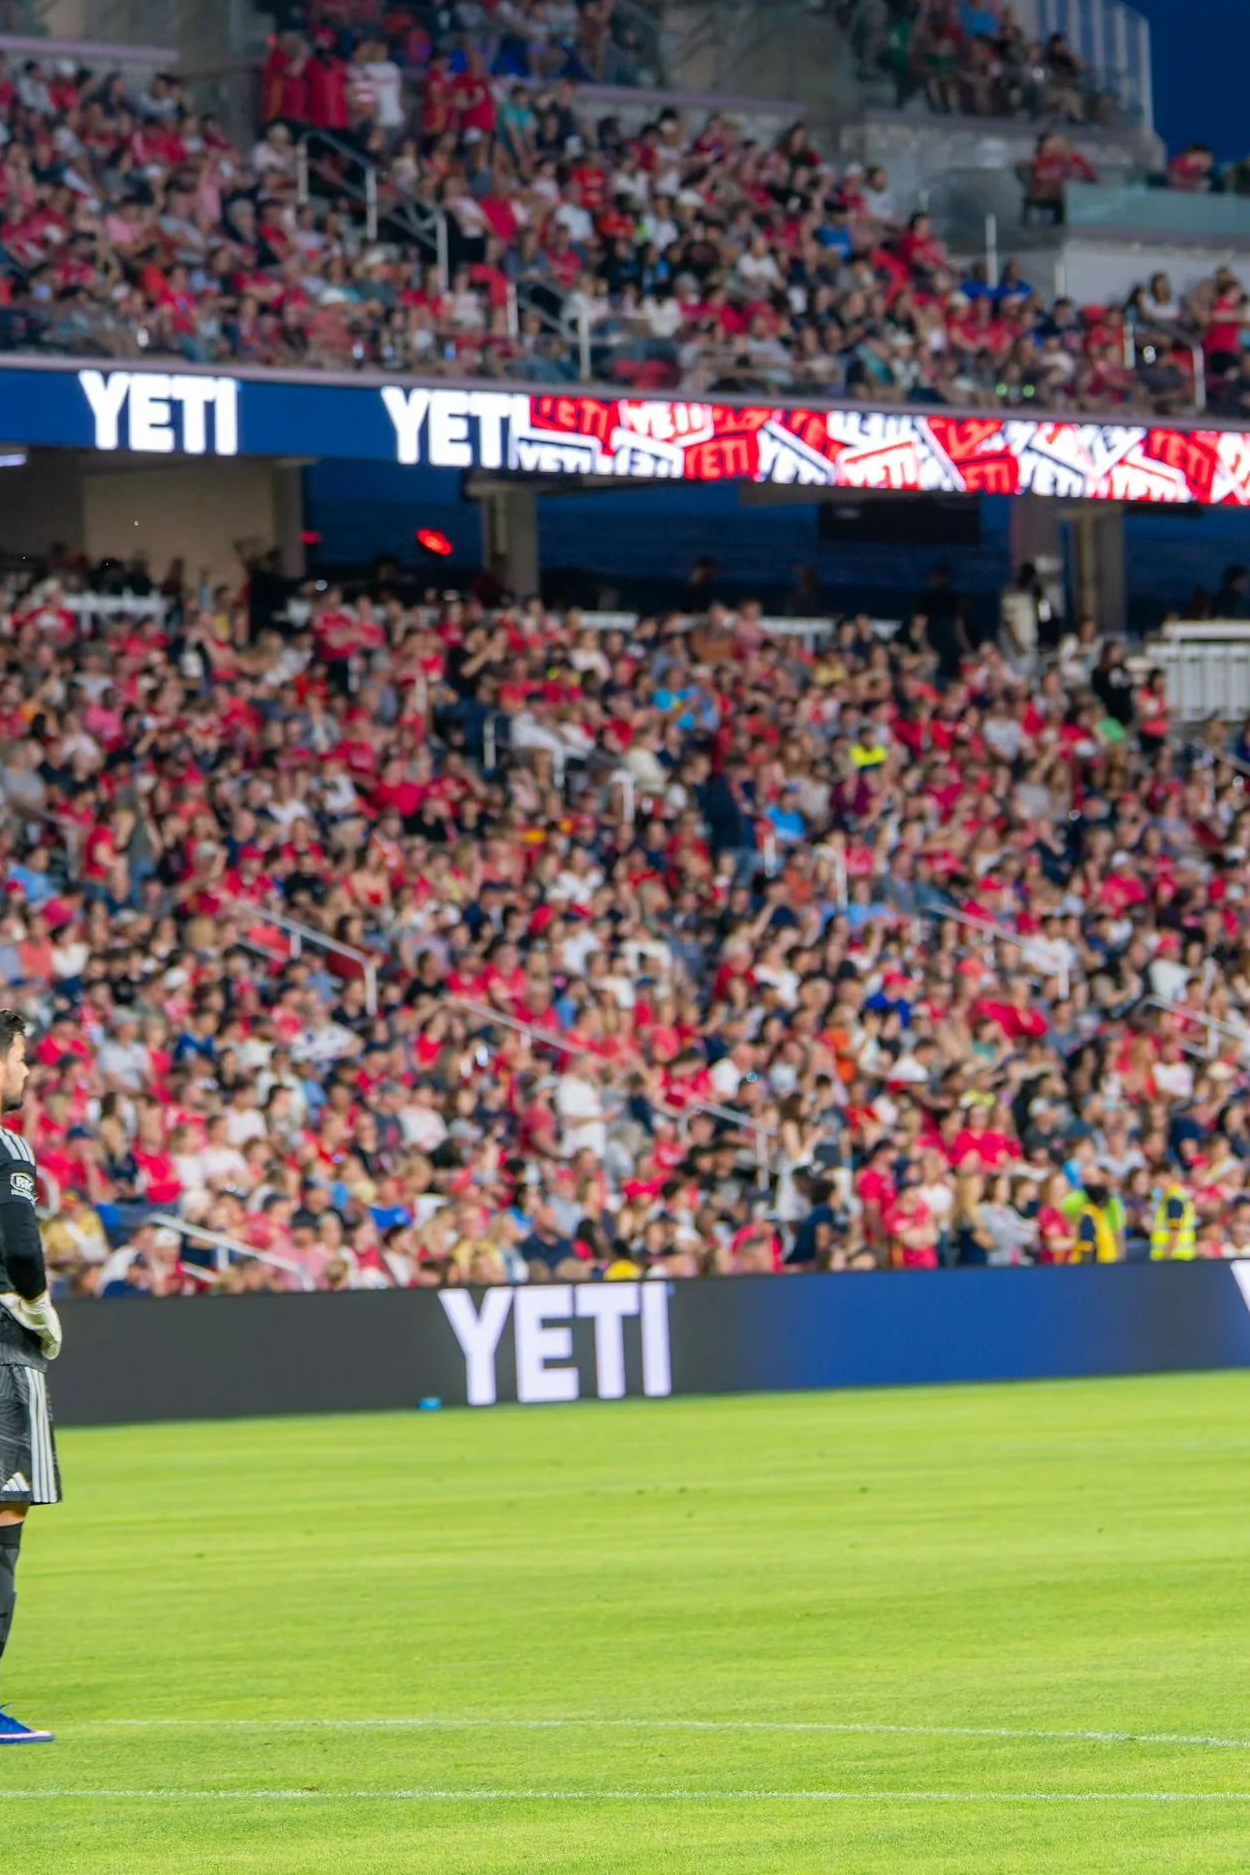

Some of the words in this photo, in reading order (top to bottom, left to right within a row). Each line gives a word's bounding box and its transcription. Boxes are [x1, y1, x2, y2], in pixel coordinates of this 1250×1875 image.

[79, 371, 238, 455] YETI
[381, 386, 530, 468] YETI
[440, 1282, 671, 1405] YETI
